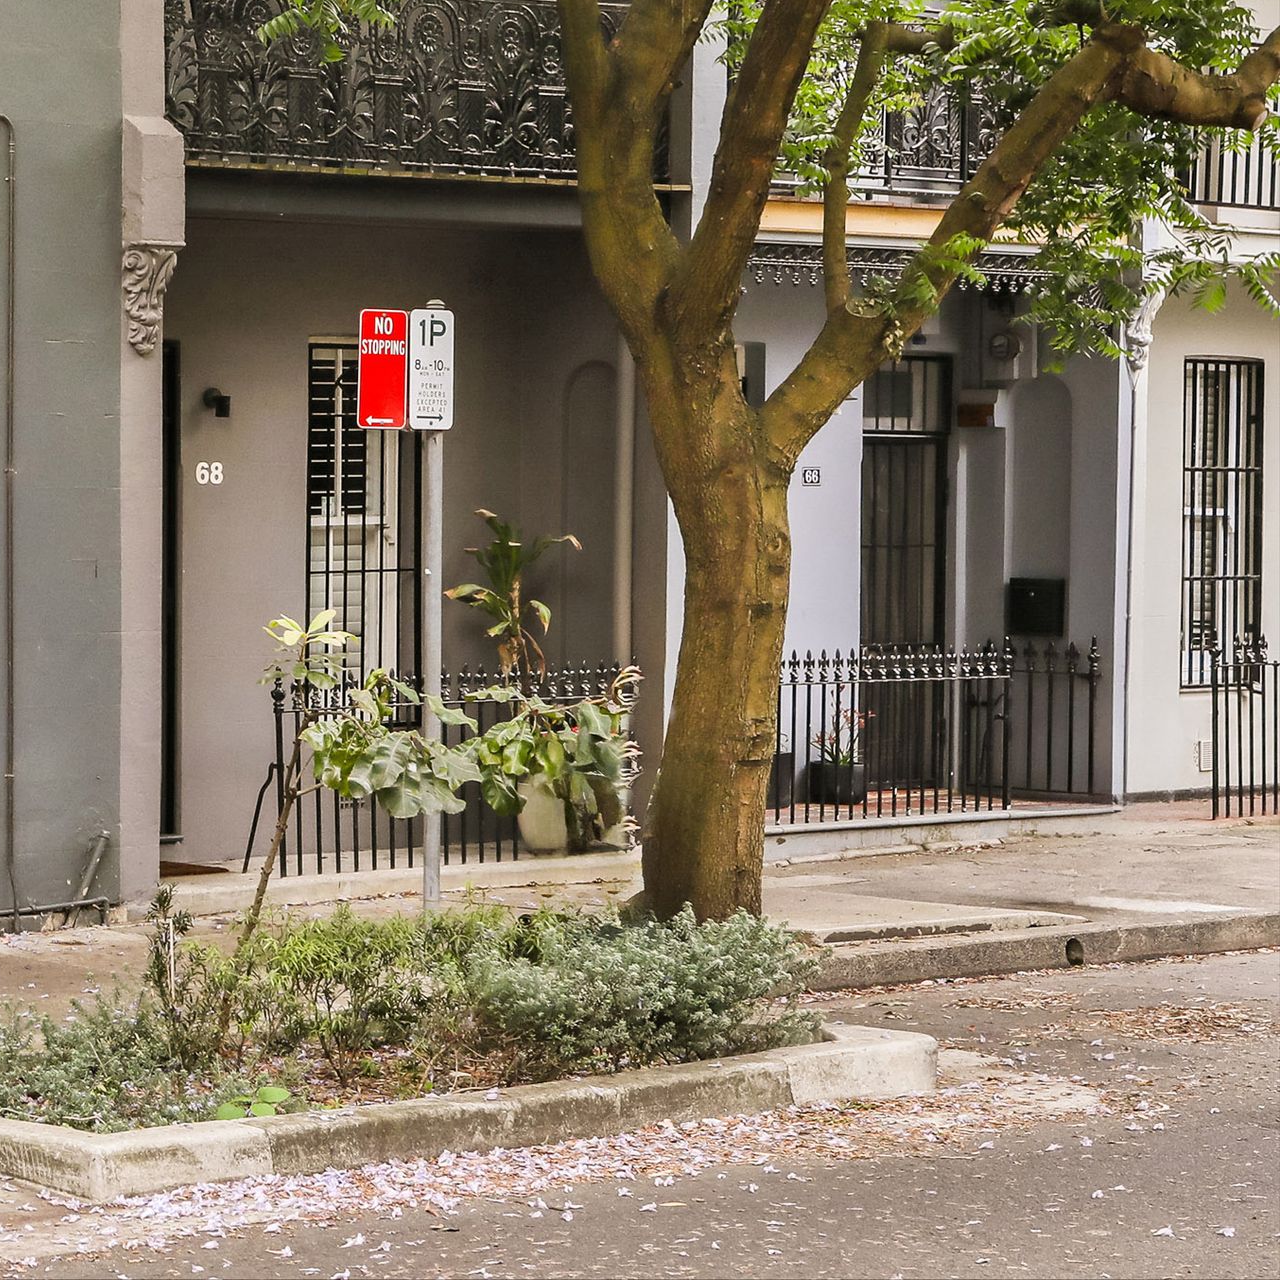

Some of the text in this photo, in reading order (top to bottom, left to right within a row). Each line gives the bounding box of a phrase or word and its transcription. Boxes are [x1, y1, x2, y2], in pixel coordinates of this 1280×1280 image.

[374, 316, 393, 335] NO
[419, 319, 446, 347] 1P
[361, 339, 406, 356] STOPPING
[420, 382, 443, 390] PERMIT
[418, 390, 446, 398] HOLDERS
[416, 398, 448, 406] EXCEPTED
[417, 405, 435, 413] AREA
[195, 461, 224, 485] 68
[805, 469, 819, 483] 66
